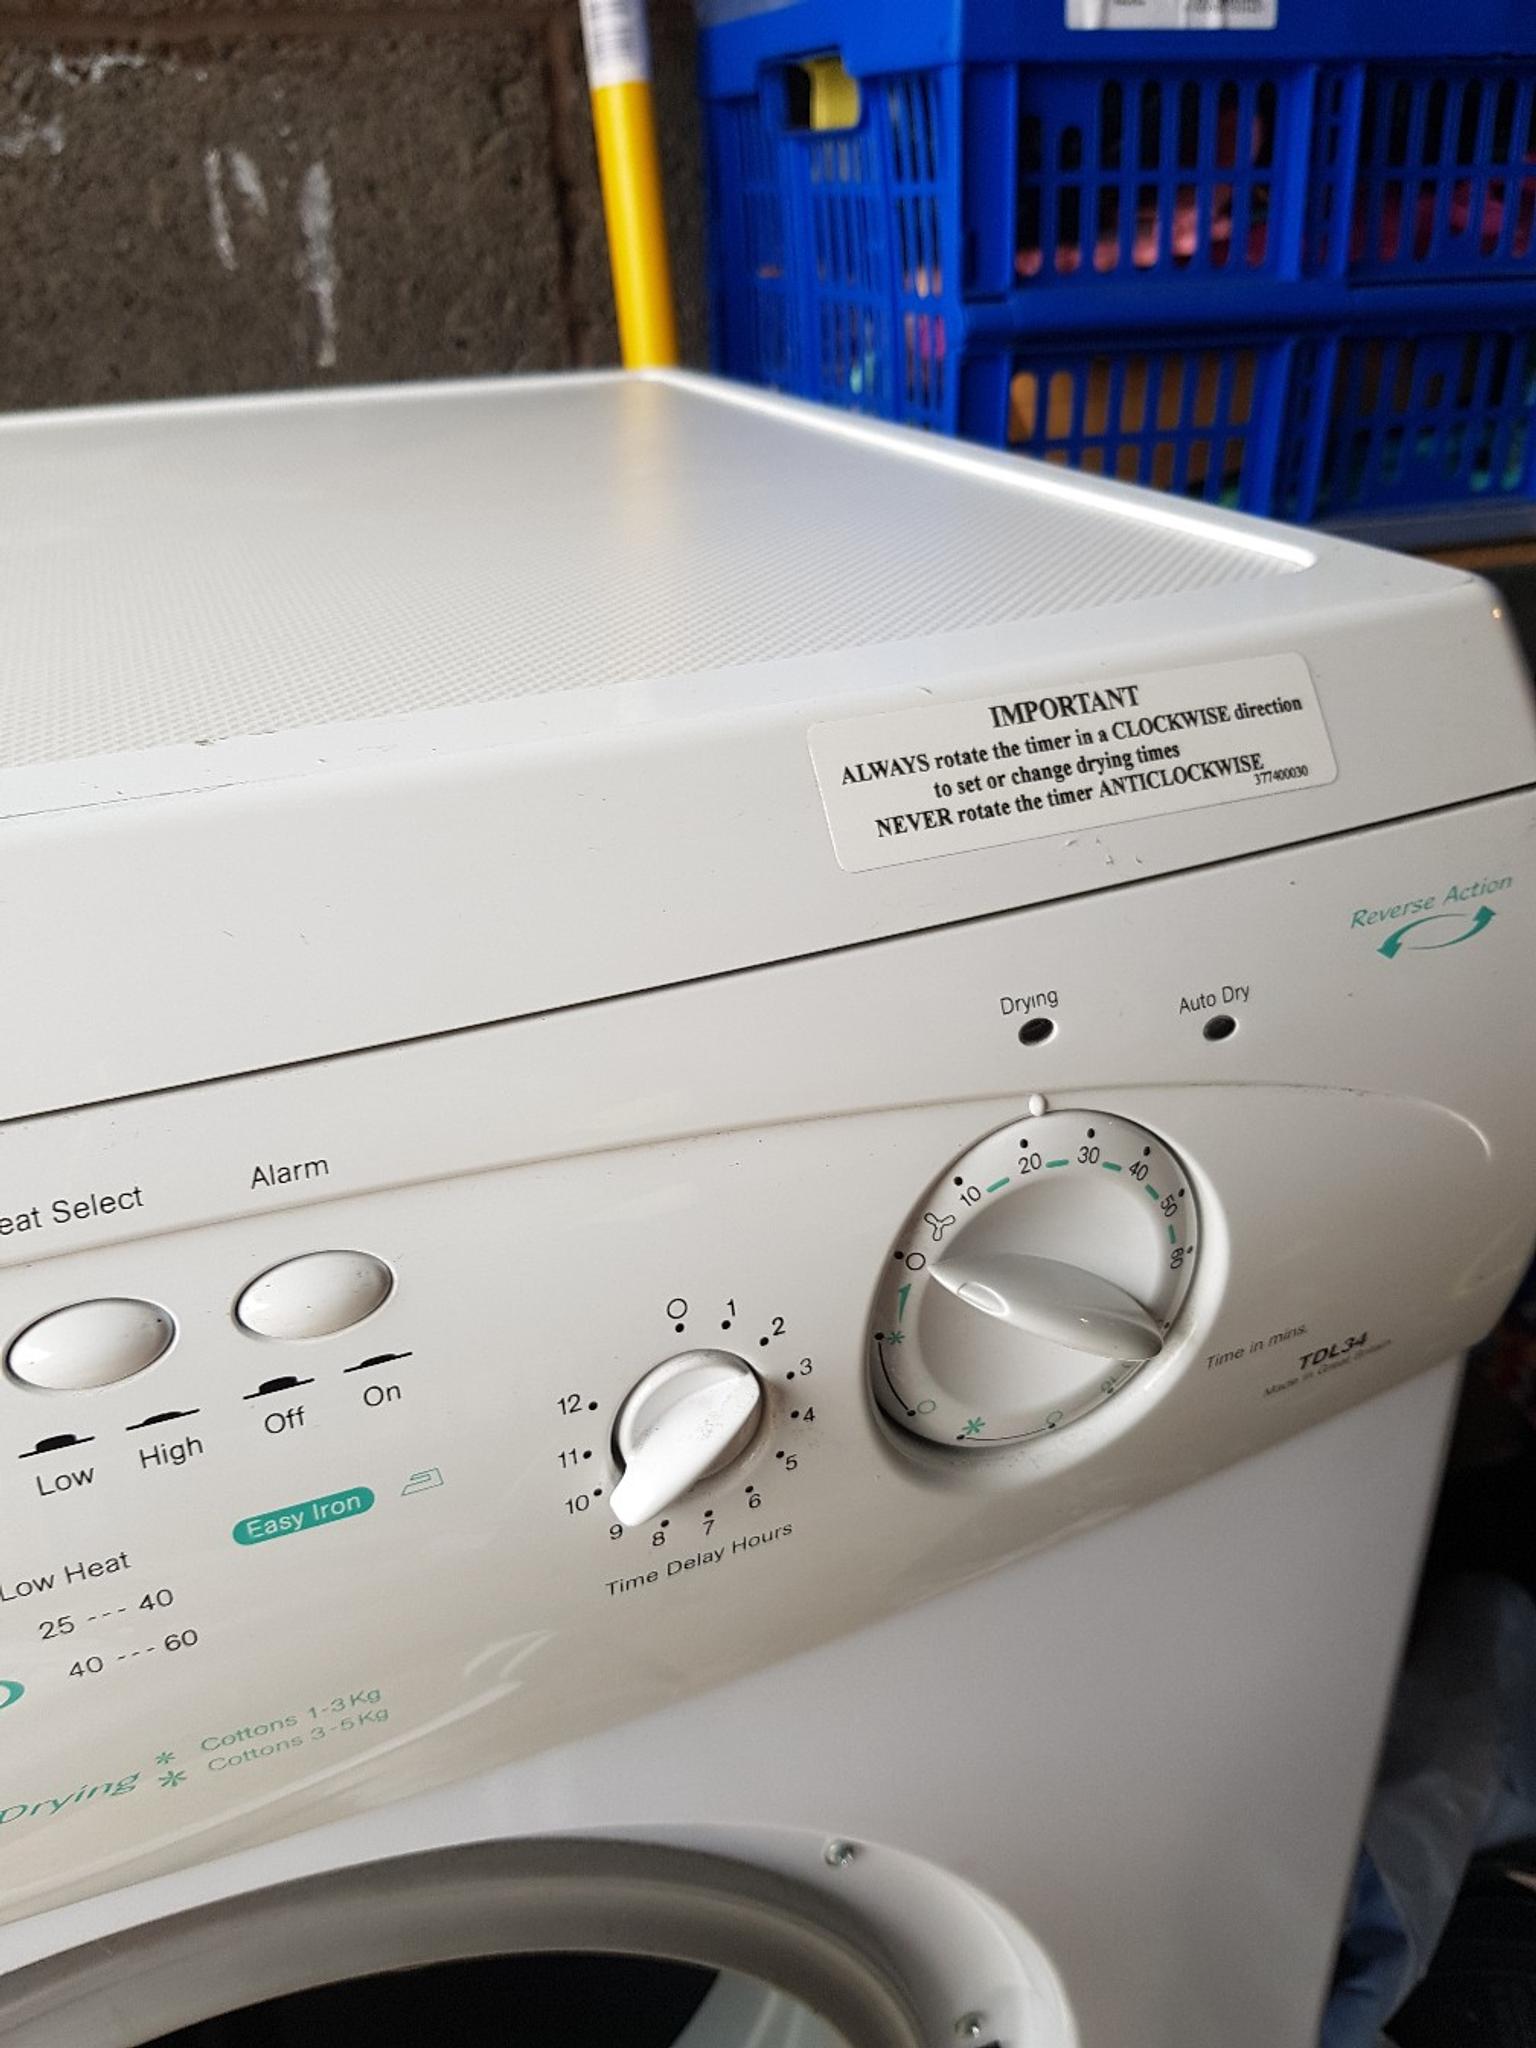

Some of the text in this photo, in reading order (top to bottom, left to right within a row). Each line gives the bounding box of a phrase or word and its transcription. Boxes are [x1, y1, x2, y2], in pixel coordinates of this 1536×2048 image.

[988, 685, 1140, 729] IMPORTANT
[840, 697, 1304, 786] ALWAYS rotate the timer in a CLOCKWISE direction
[934, 743, 1181, 799] to set or change drying times
[875, 753, 1264, 838] NEVER rotate the timer ANTICLOCKWISE
[1350, 876, 1514, 930] Reverse Action
[1000, 989, 1060, 1016] Drying
[1178, 984, 1251, 1016] Auto Dry
[1018, 1152, 1042, 1175] 20
[1077, 1146, 1100, 1165] 30
[250, 1157, 331, 1190] Alarm
[1129, 1160, 1149, 1182] 40
[52, 1185, 145, 1225] Select
[960, 1185, 982, 1208] 10
[1160, 1194, 1178, 1218] 50
[1170, 1247, 1184, 1269] 60
[726, 1298, 737, 1317] 1
[771, 1316, 786, 1336] 2
[799, 1357, 813, 1376] 3
[1206, 1348, 1245, 1371] Time
[1249, 1340, 1265, 1355] in
[362, 1383, 402, 1409] On
[556, 1394, 583, 1416] 12
[264, 1404, 307, 1434] Off
[803, 1406, 816, 1423] 4
[138, 1436, 205, 1470] High
[557, 1448, 580, 1469] 11
[785, 1454, 799, 1471] 5
[36, 1463, 96, 1497] Low
[565, 1494, 590, 1515] 10
[748, 1493, 762, 1510] 6
[246, 1492, 362, 1541] Easy Iron
[702, 1519, 716, 1537] 7
[609, 1523, 624, 1541] 9
[652, 1531, 666, 1547] 8
[605, 1522, 793, 1597] Time Delay Hours
[0, 1551, 133, 1602] Low Heat
[39, 1614, 76, 1641] 25
[138, 1588, 174, 1611] 40
[68, 1656, 104, 1679] 40
[164, 1629, 199, 1652] 60
[200, 1715, 298, 1751] Cottons
[208, 1735, 304, 1772] Cottons
[0, 1771, 142, 1824] Drying
